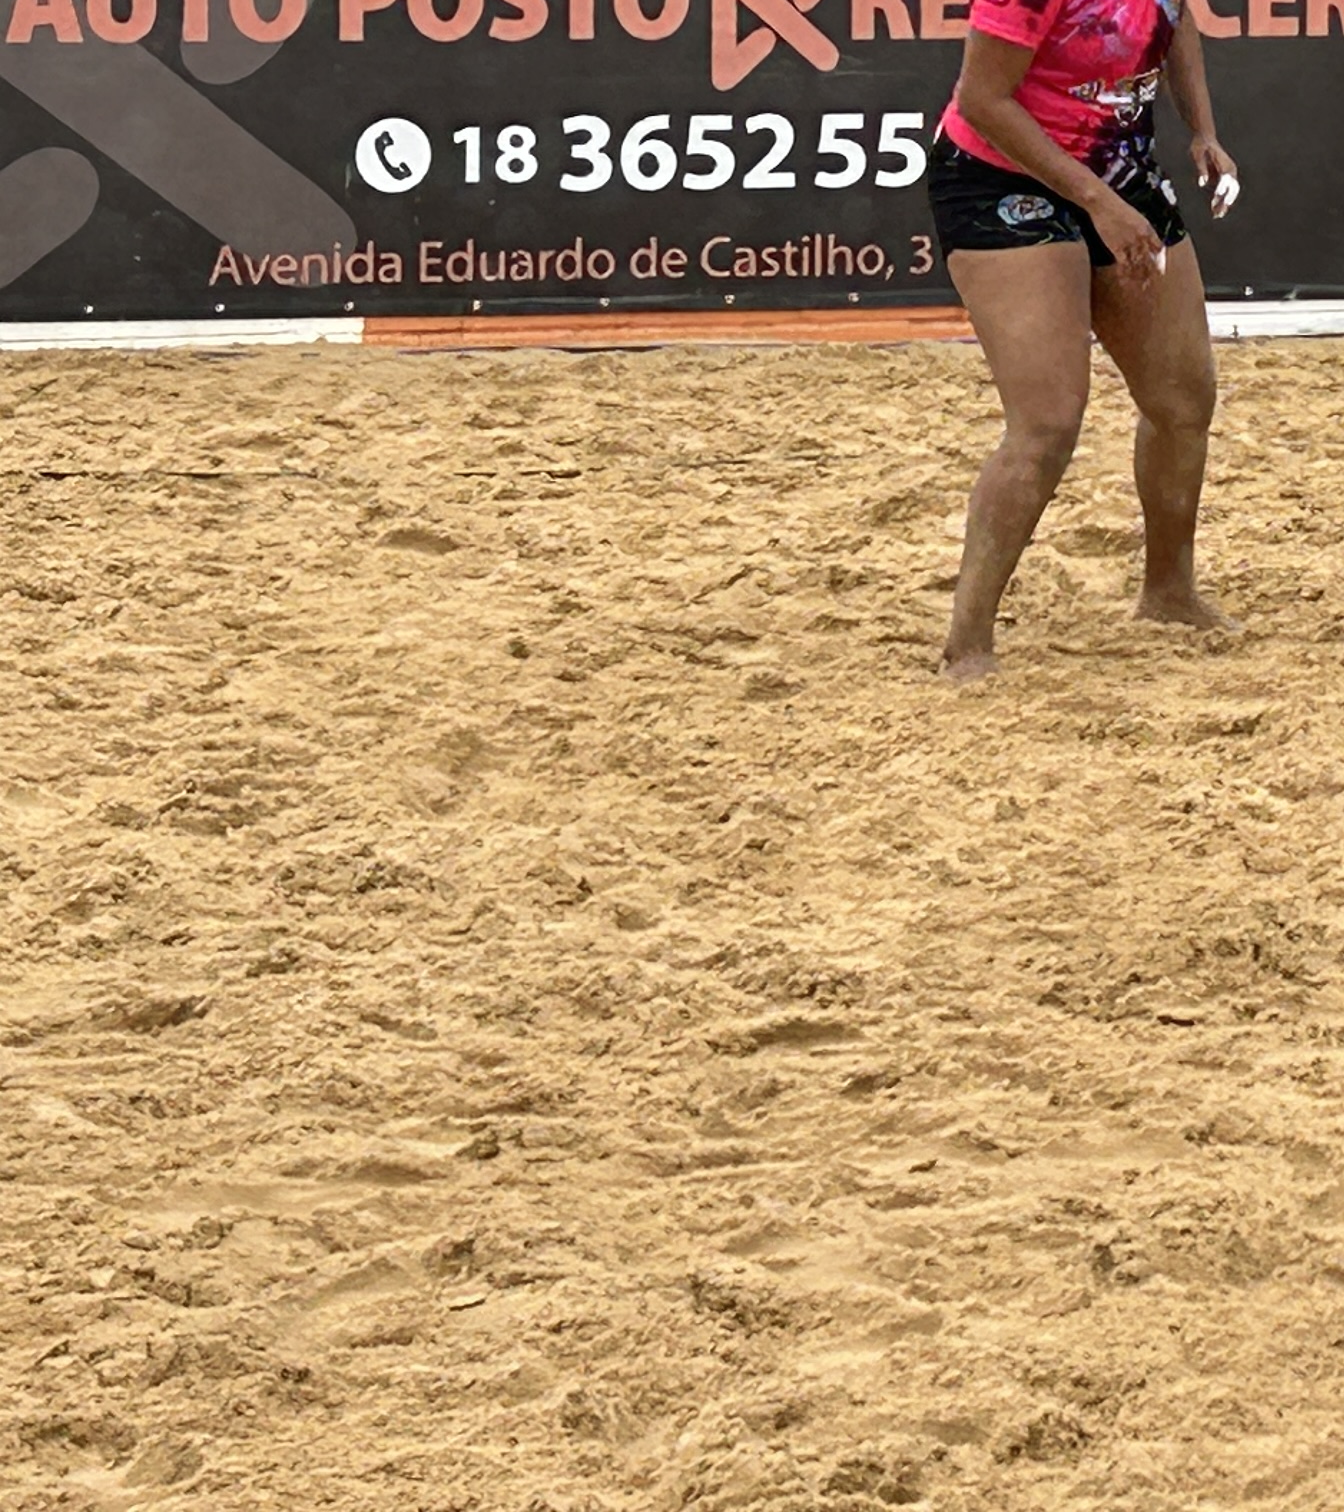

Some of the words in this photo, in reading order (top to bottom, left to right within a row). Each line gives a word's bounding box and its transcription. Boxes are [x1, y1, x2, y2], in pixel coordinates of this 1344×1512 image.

[452, 124, 539, 184] 18
[559, 112, 797, 193] 3652
[814, 111, 928, 189] 55
[207, 238, 403, 287] Avenida
[418, 236, 617, 284] Eduardo
[629, 237, 689, 279] de
[699, 233, 897, 281] Castilho,
[908, 235, 935, 275] 3
